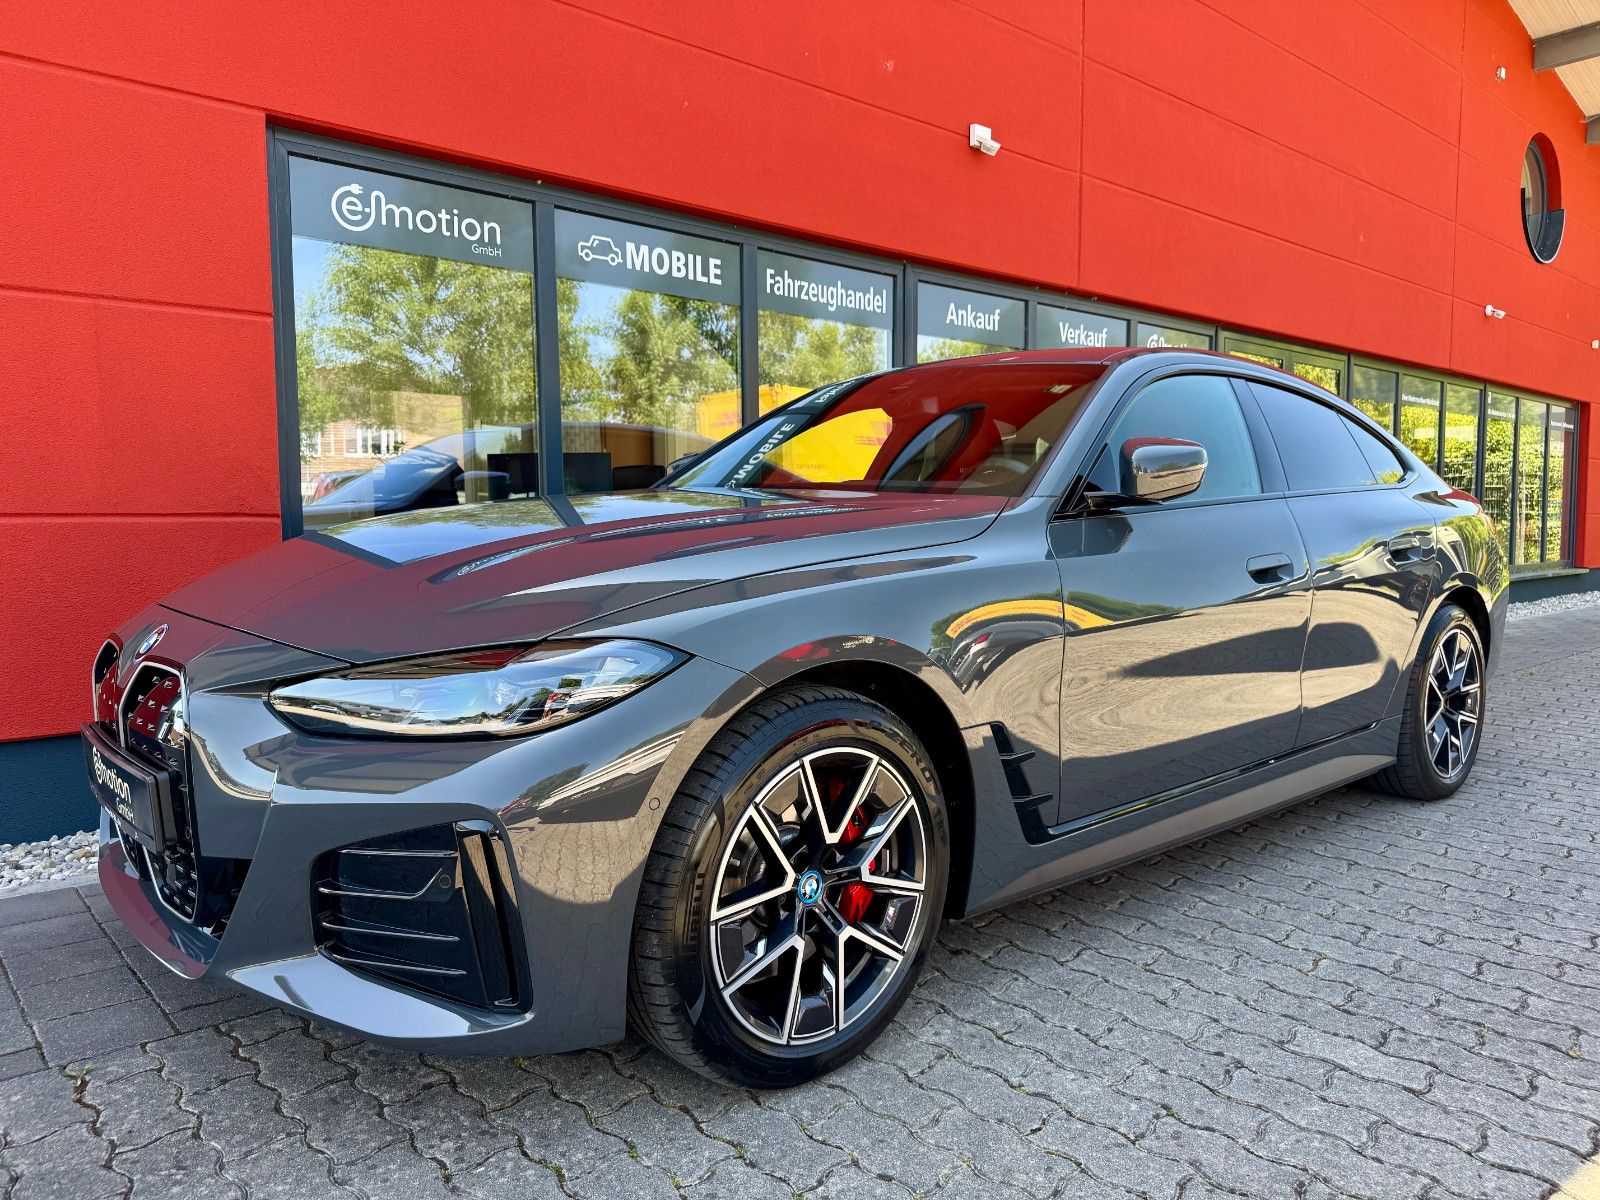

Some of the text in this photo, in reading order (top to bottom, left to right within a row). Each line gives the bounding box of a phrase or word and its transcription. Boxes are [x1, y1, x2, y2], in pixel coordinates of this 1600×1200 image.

[471, 243, 502, 258] GmbH
[625, 241, 722, 286] MOBILE
[765, 268, 887, 314] Fahrzeughandel
[946, 302, 1000, 333] Ankauf
[1059, 321, 1108, 347] Verkauf
